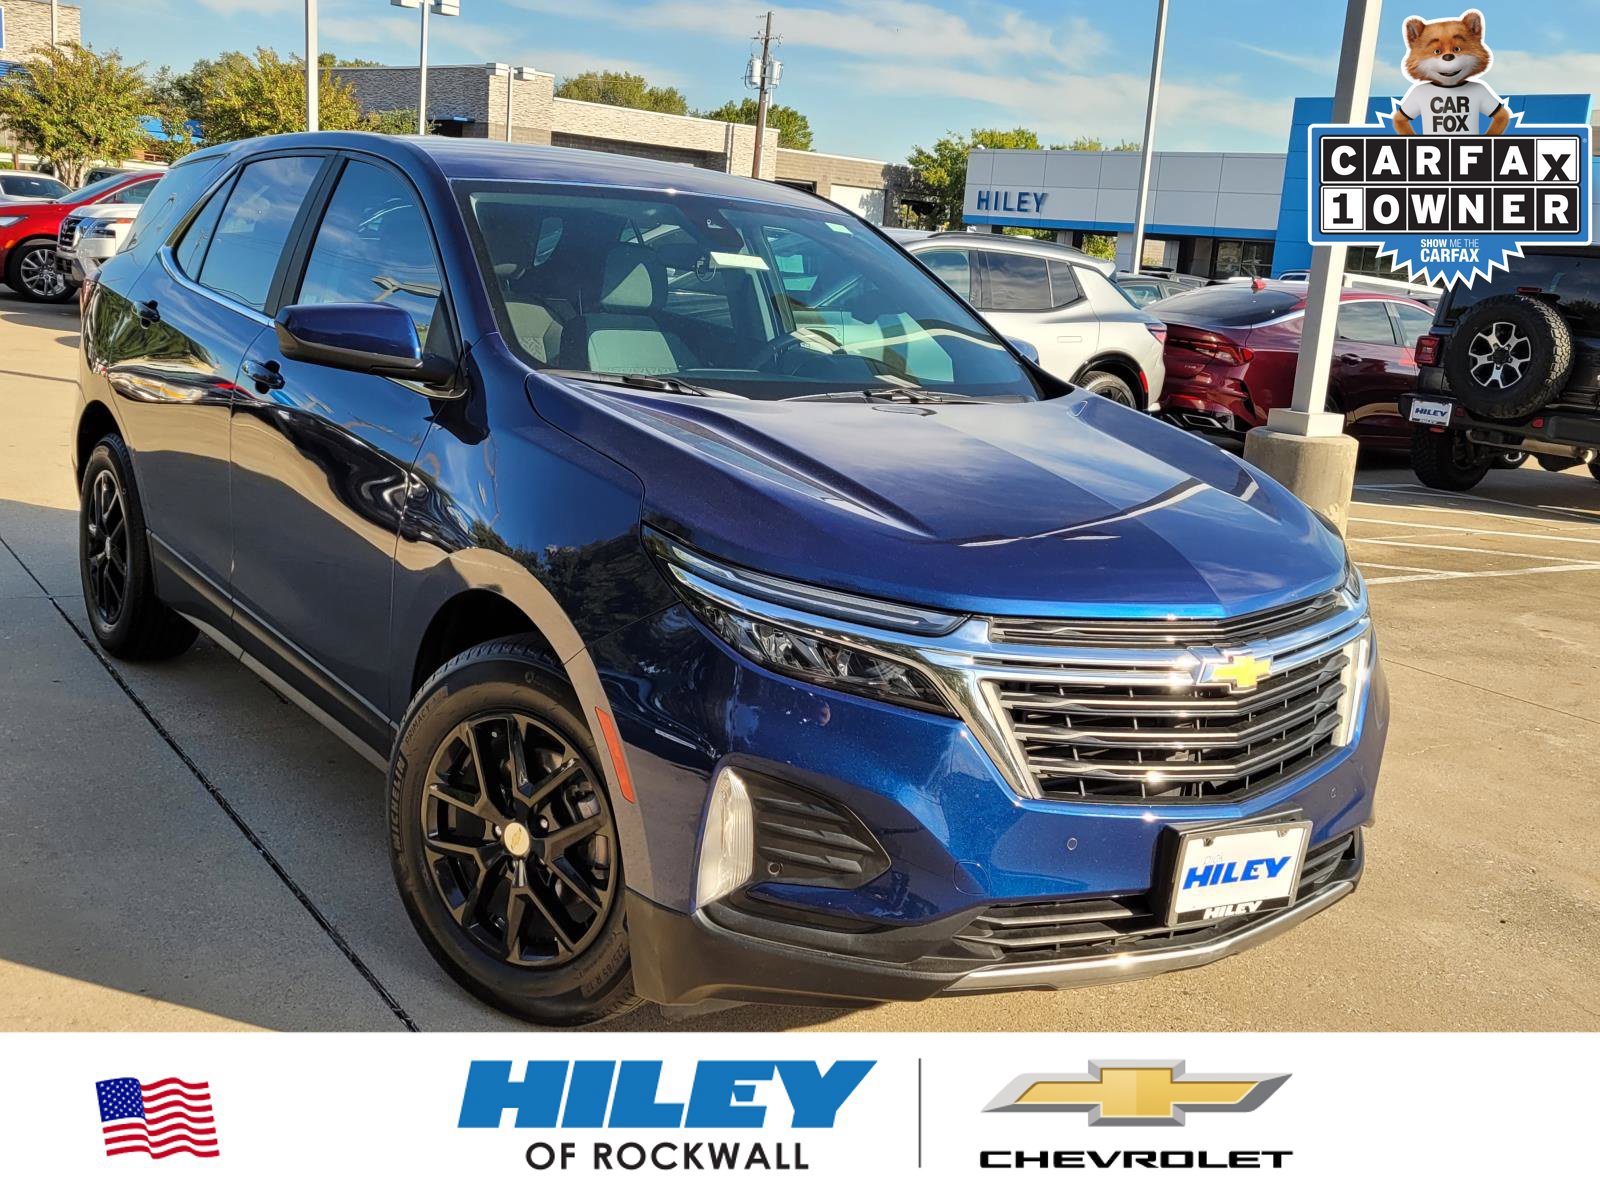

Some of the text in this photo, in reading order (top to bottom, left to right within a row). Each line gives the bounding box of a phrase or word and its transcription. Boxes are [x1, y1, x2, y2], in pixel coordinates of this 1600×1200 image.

[977, 190, 1049, 213] HILEY
[1415, 408, 1448, 417] HILEY
[391, 756, 405, 850] MICHELIN
[1182, 856, 1292, 890] HILEY
[1203, 900, 1263, 920] HILEY
